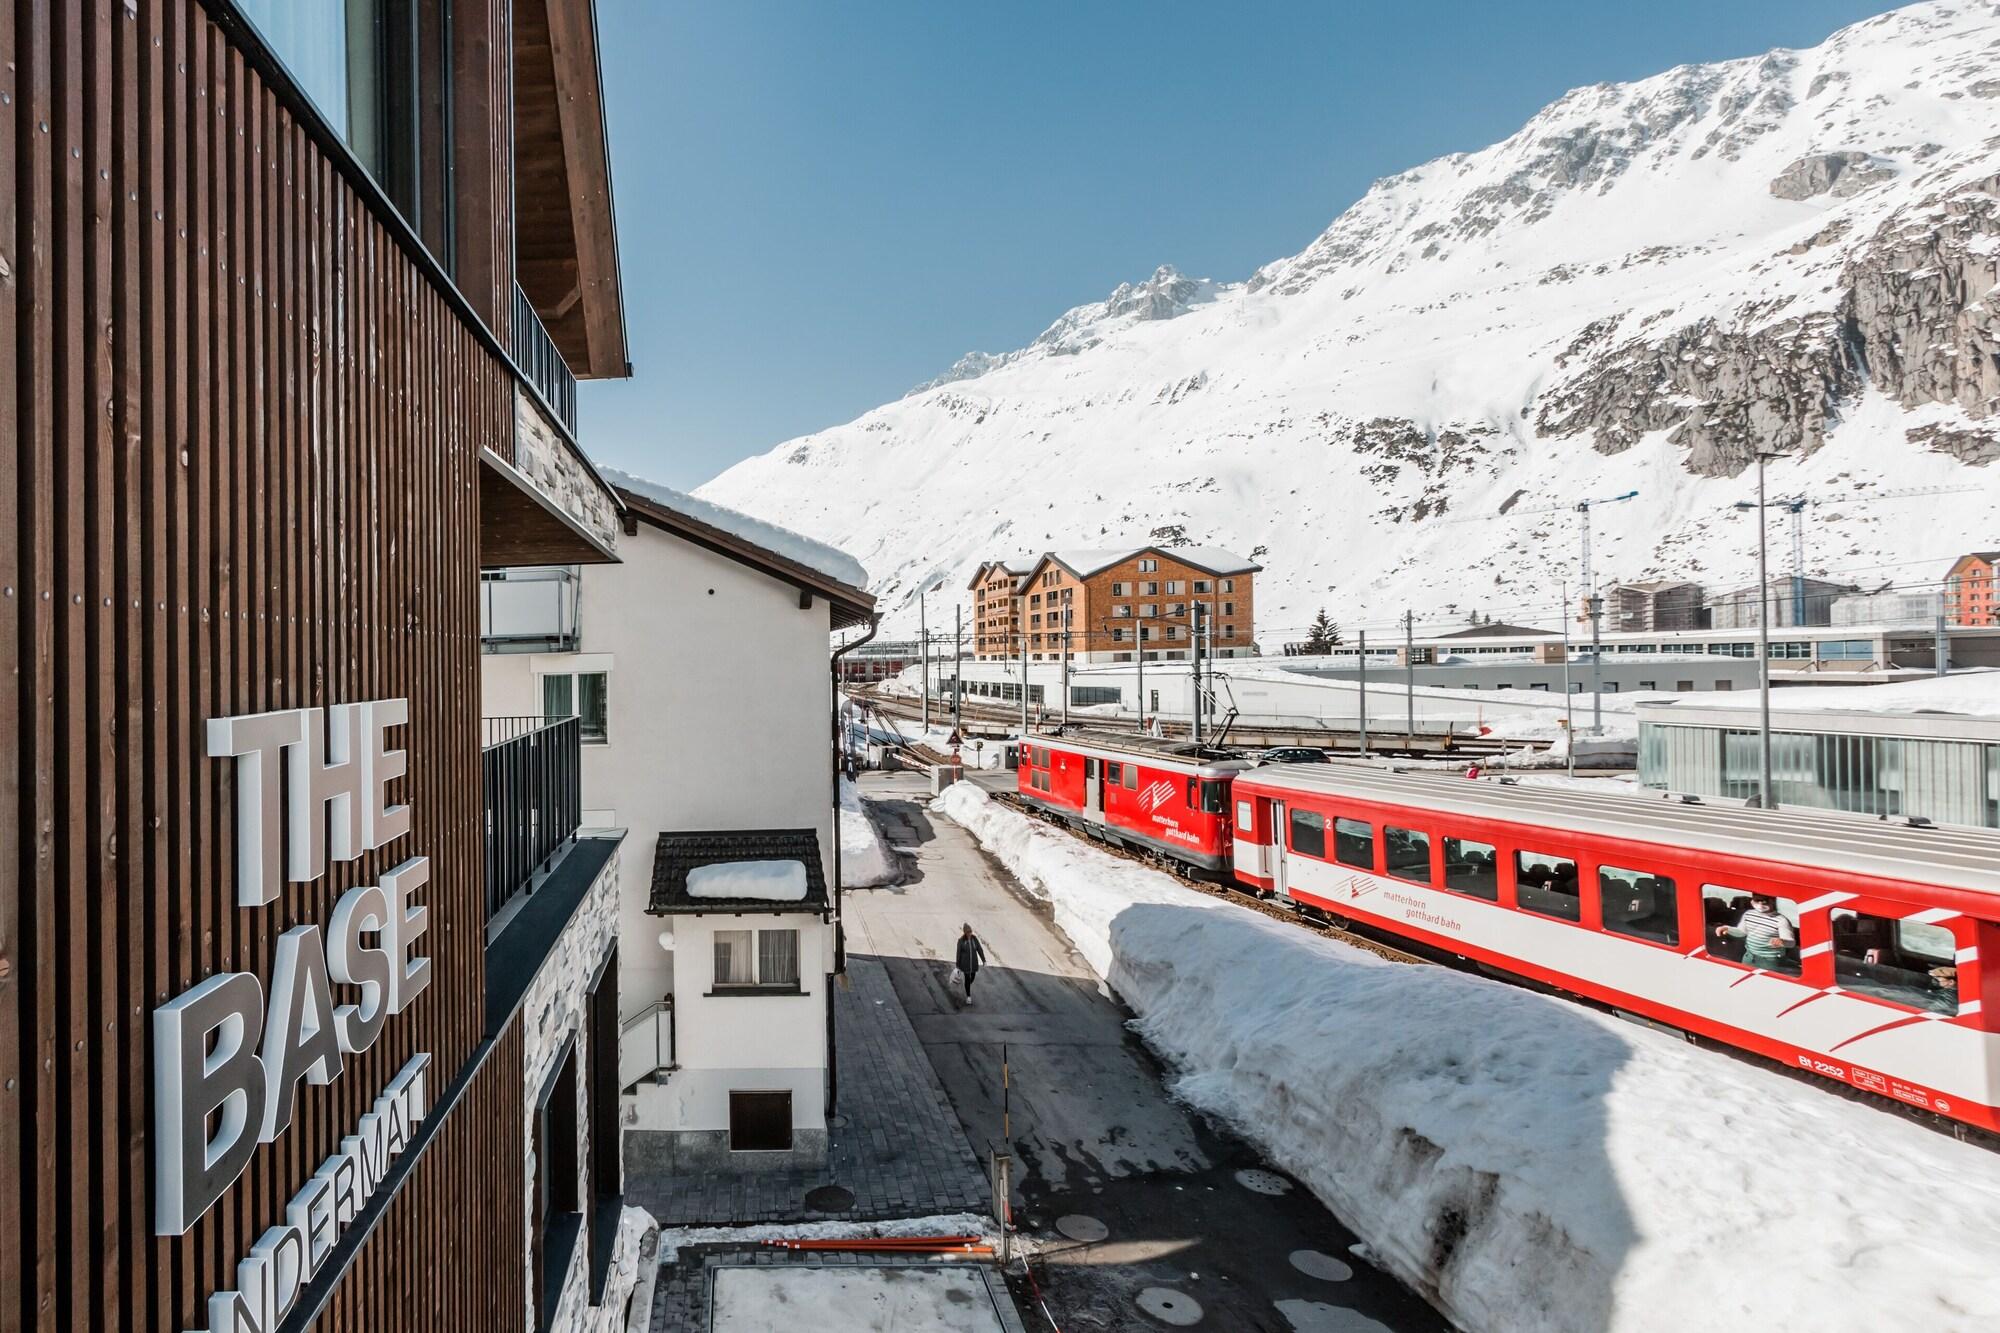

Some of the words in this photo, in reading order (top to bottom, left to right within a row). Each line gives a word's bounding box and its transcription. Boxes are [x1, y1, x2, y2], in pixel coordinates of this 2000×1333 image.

[207, 698, 410, 906] THE
[1325, 818, 1332, 830] 2
[1383, 890, 1426, 909] matterhorn
[1406, 908, 1440, 925] gotthard
[1440, 915, 1461, 931] bahn
[154, 857, 431, 1236] BASE
[1798, 1055, 1813, 1069] Bt
[1814, 1061, 1846, 1079] 2252
[182, 1053, 431, 1333] NDERMATT
